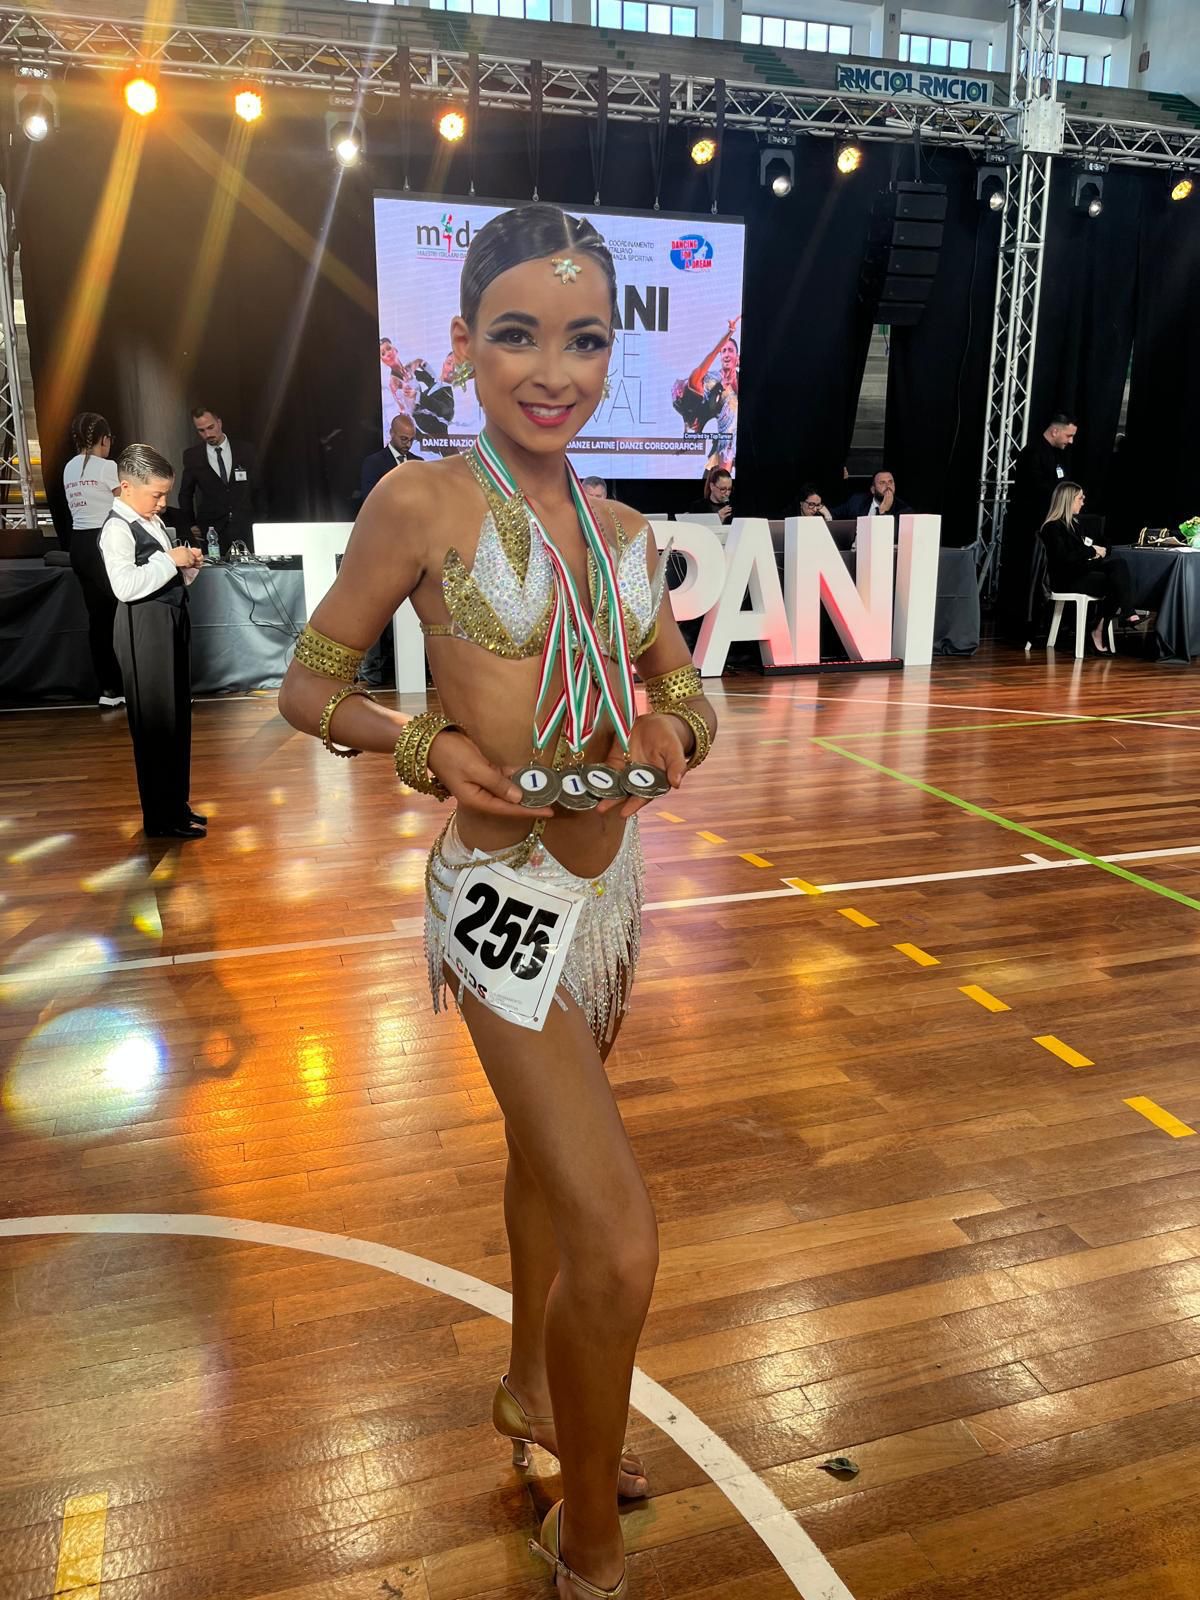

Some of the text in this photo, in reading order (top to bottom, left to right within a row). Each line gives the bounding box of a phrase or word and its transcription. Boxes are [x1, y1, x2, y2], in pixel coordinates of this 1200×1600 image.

[839, 66, 988, 103] RMC101 RMC101
[671, 240, 698, 250] DANCING
[612, 253, 627, 261] ANZA
[692, 259, 712, 269] DREAM
[422, 438, 448, 447] DANZE
[644, 443, 704, 451] COREOGRAFICHE
[529, 772, 538, 789] 1
[592, 773, 610, 784] 1
[635, 771, 649, 784] 1
[570, 777, 580, 793] 1
[454, 882, 559, 981] 255
